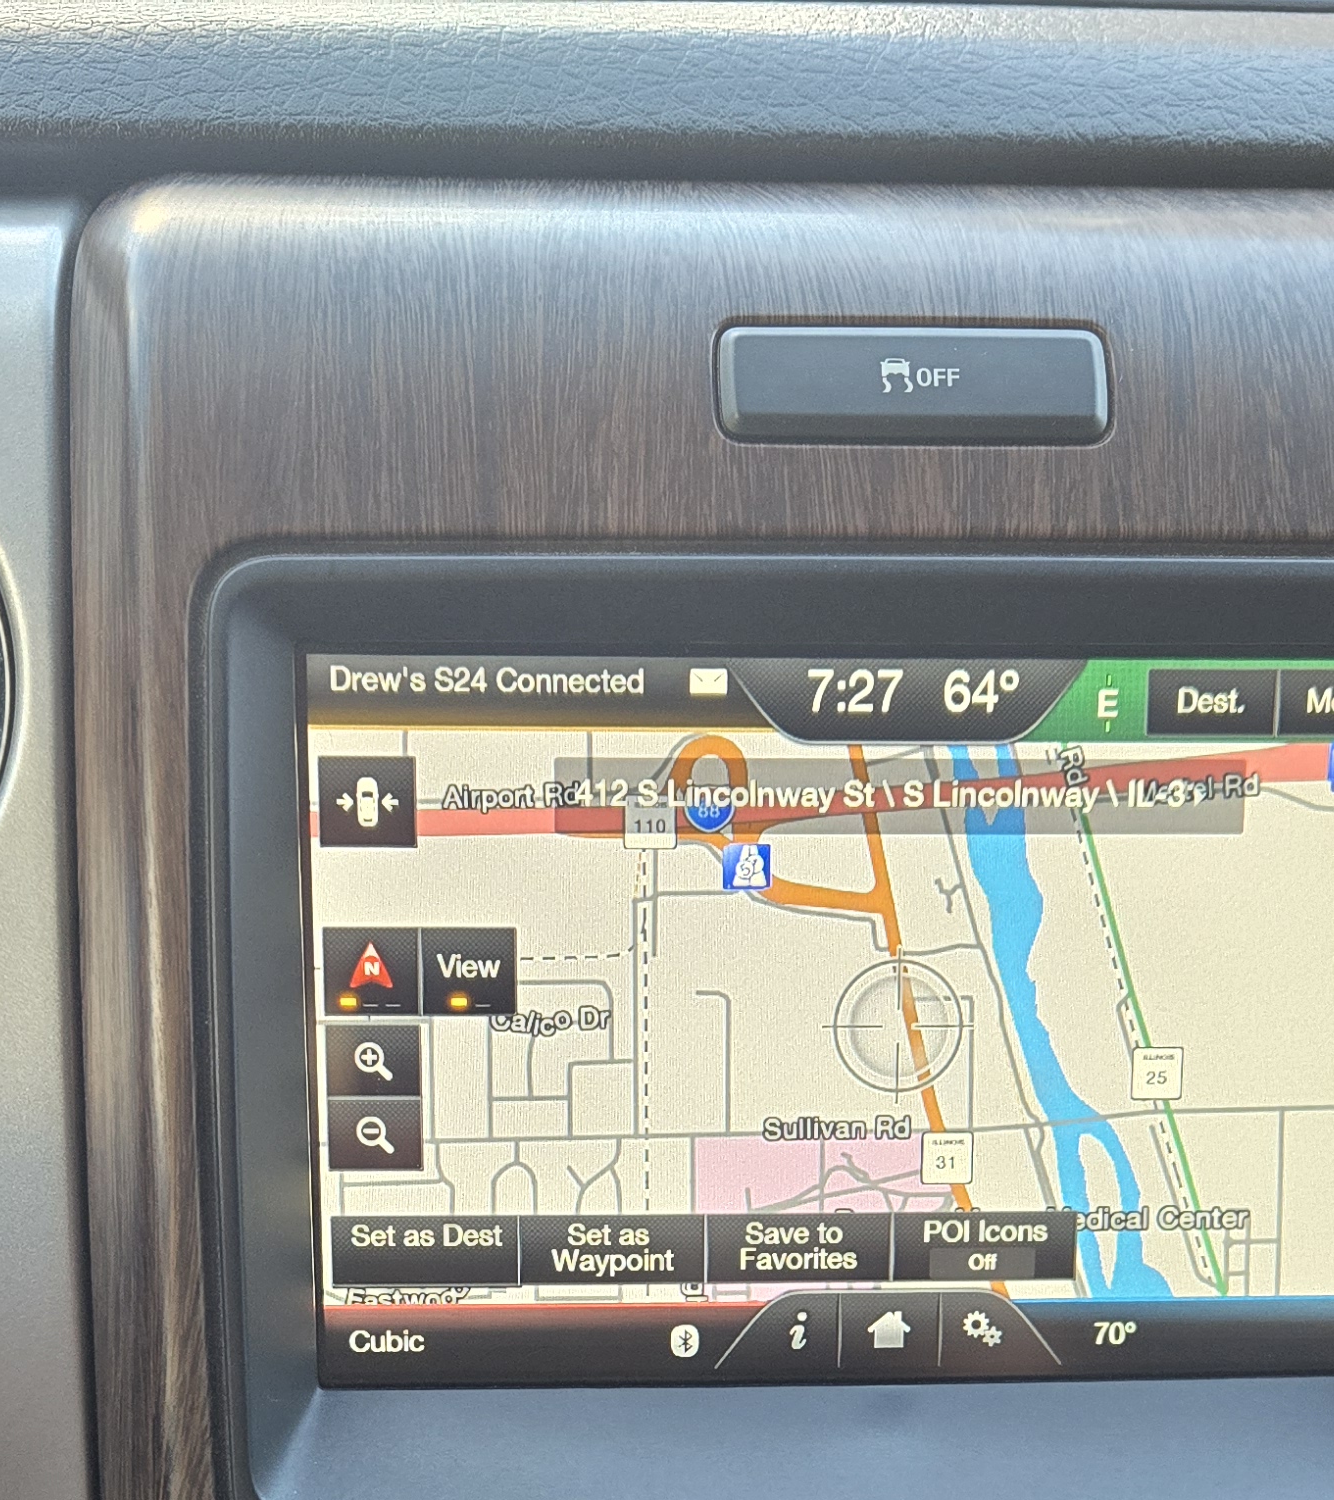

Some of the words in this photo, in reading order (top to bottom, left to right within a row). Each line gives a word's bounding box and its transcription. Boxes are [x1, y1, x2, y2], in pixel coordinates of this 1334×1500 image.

[916, 367, 960, 388] OFF
[329, 665, 427, 692] Drew's
[434, 666, 488, 692] S24
[496, 666, 645, 694] Connected
[807, 668, 904, 714] 7:27
[943, 668, 1020, 714] 64°
[1097, 690, 1119, 719] E
[1176, 688, 1246, 715] Dest.
[1059, 745, 1089, 787] Rd
[441, 785, 534, 813] Airport
[544, 782, 578, 807] Rd
[576, 779, 632, 807] 412
[637, 779, 659, 807] S
[669, 779, 836, 811] Lincolnway
[843, 780, 874, 807] St
[903, 780, 925, 807] S
[933, 779, 1100, 813] Lincolnway
[1224, 771, 1261, 799] Rd
[634, 819, 666, 834] 110
[364, 961, 380, 976] N
[436, 952, 501, 980] View
[489, 1008, 572, 1037] Calico
[578, 1005, 611, 1031] Dr
[1145, 1069, 1168, 1086] 25
[763, 1116, 865, 1142] Sullivan
[875, 1116, 911, 1142] Rd
[935, 1155, 955, 1170] 31
[922, 1219, 970, 1243] POI
[977, 1219, 1048, 1243] Icons
[1157, 1205, 1250, 1231] Center
[350, 1224, 396, 1247] Set
[403, 1229, 435, 1247] as
[443, 1223, 503, 1247] Dest
[567, 1223, 612, 1246] Set
[618, 1229, 650, 1246] as
[745, 1221, 810, 1245] Save
[817, 1222, 844, 1244] to
[551, 1248, 674, 1277] Waypoint
[739, 1246, 858, 1271] Favorites
[967, 1252, 998, 1272] Off
[348, 1329, 425, 1354] Cubic
[1093, 1321, 1137, 1345] 70°
